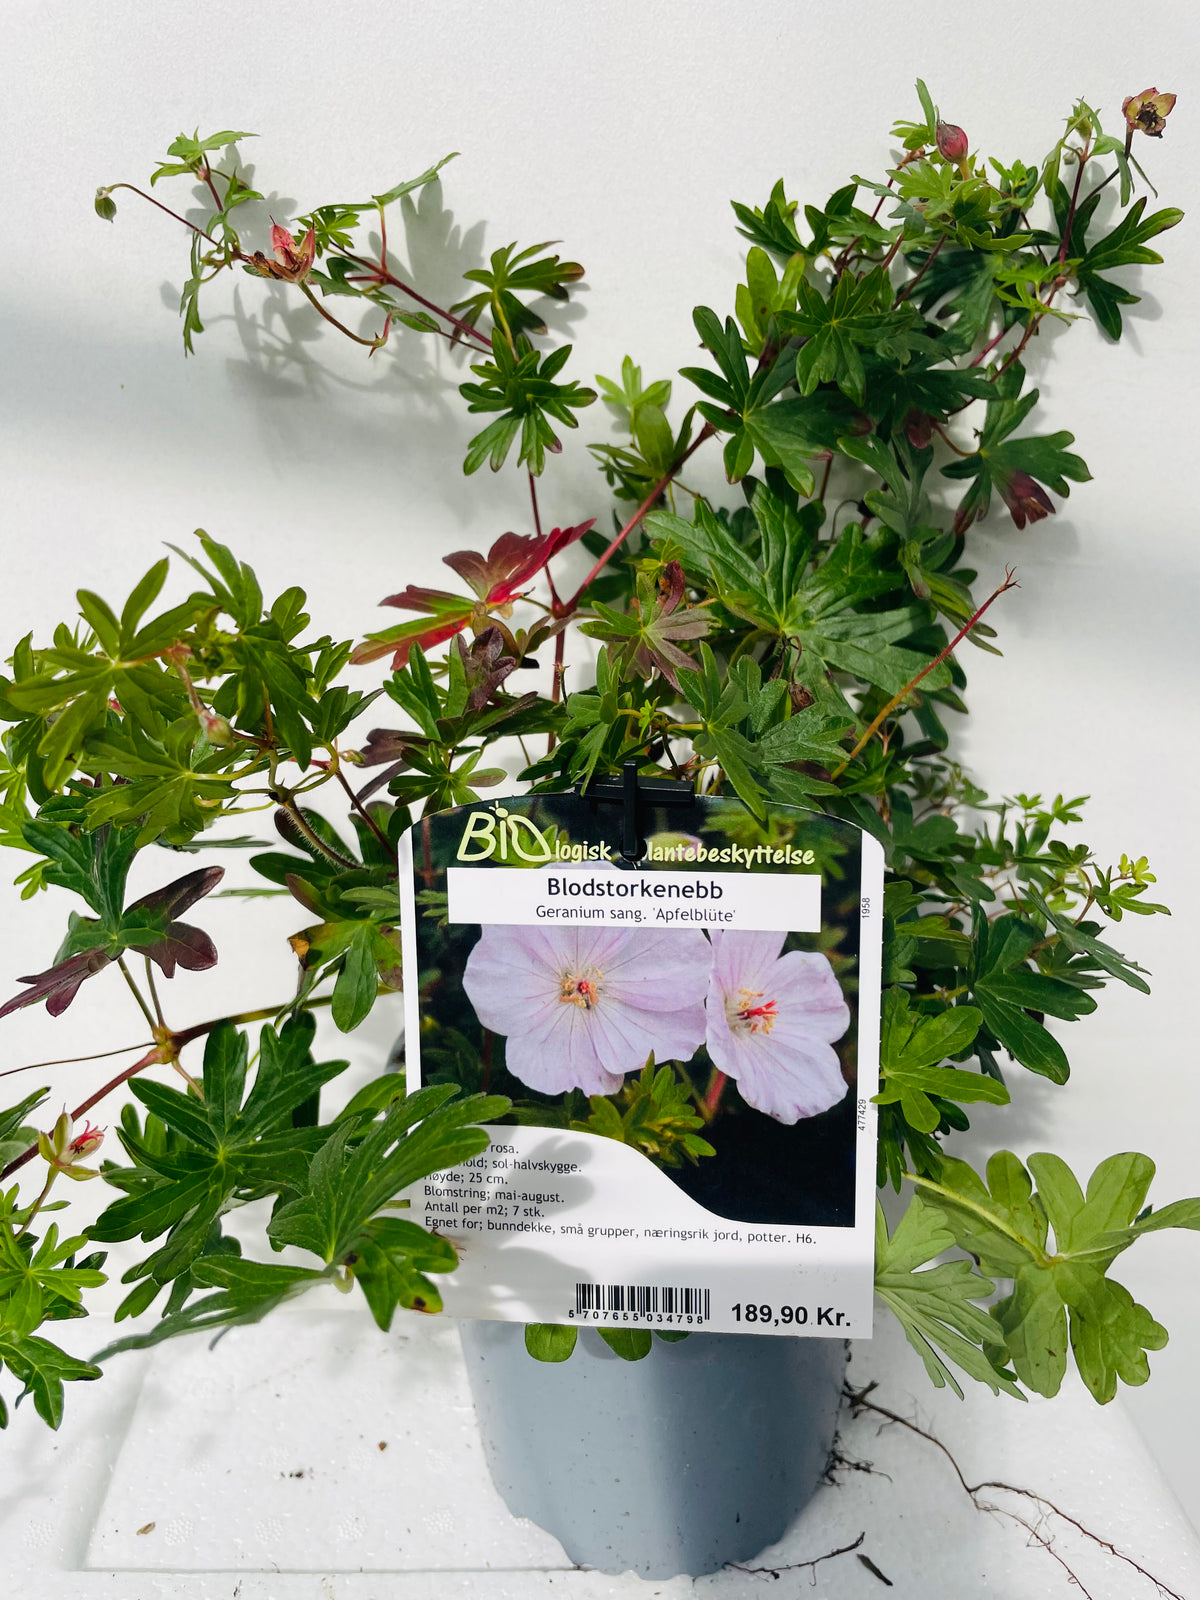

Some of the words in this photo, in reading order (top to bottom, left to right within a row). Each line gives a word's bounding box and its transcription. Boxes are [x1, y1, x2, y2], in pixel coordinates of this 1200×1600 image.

[638, 841, 815, 869] lantebeskyttelse
[547, 877, 724, 899] Blodstorkenebb
[536, 905, 605, 919] Geranium
[610, 908, 647, 922] sang.
[861, 897, 870, 919] 1958
[857, 1098, 867, 1131] 477429
[490, 1144, 519, 1154] rosa.
[492, 1158, 582, 1173] sol-halvskygge.
[469, 1172, 483, 1183] 25
[486, 1175, 509, 1185] cm.
[424, 1185, 490, 1201] Blomstring;
[495, 1189, 565, 1204] mai-august.
[425, 1201, 459, 1212] Antall
[463, 1205, 482, 1215] per
[486, 1204, 509, 1216] m2;
[513, 1205, 520, 1215] 7
[523, 1206, 545, 1217] stk.
[425, 1216, 458, 1228] Egnet
[462, 1218, 483, 1231] for;
[487, 1219, 556, 1234] bunndekke,
[560, 1222, 583, 1235] små
[587, 1226, 639, 1239] grupper,
[644, 1227, 709, 1241] næringsrik
[713, 1229, 743, 1243] jord,
[747, 1231, 791, 1245] potter.
[796, 1233, 817, 1244] H6.
[731, 1303, 808, 1327] 189,90
[816, 1307, 851, 1327] Kr.
